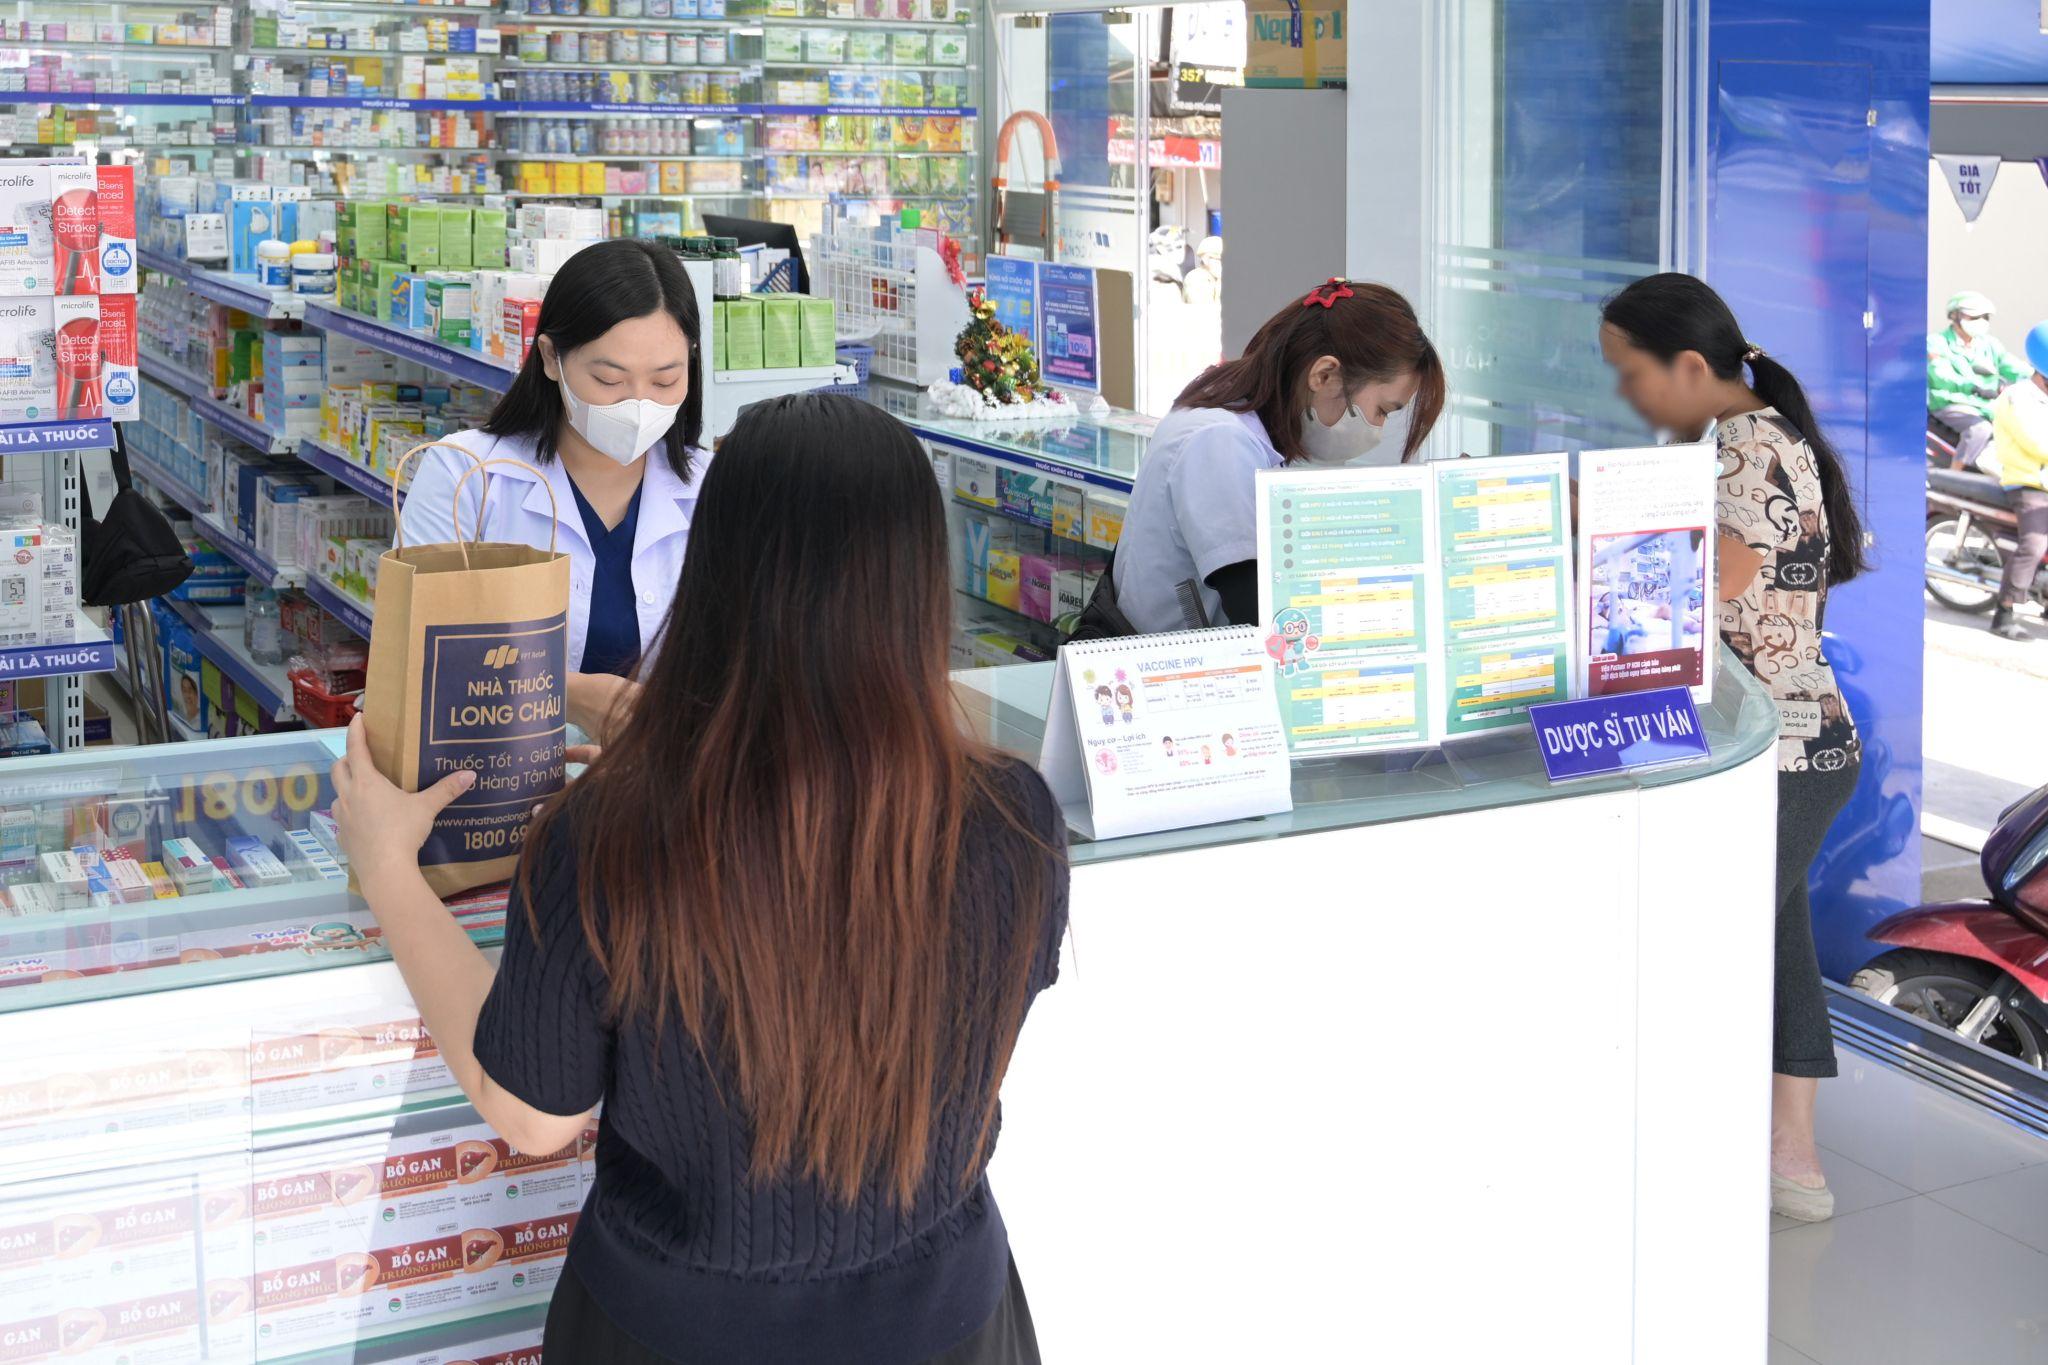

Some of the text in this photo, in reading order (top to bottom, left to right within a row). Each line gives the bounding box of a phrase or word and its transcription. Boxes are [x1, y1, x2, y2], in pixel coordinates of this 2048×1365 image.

[58, 172, 92, 180] microlife
[57, 205, 96, 216] Detect
[58, 222, 97, 233] Stroke
[61, 301, 94, 309] microlife
[60, 334, 99, 345] Detect
[61, 351, 99, 362] Stroke
[19, 388, 51, 396] Advanced
[18, 430, 40, 444] LÀ
[42, 424, 99, 443] THUỐC
[19, 653, 40, 669] LÀ
[44, 647, 100, 668] THUỐC
[1137, 656, 1204, 673] VACCINE HPV
[467, 669, 554, 697] NHÀ THUỐC
[450, 694, 561, 727] LONG CHÂU
[1544, 705, 1694, 757] DƯỢC SĨ TƯ VẤN
[1087, 738, 1106, 747] Nguy
[434, 753, 485, 772] Thuốc
[488, 751, 512, 769] Tốt
[530, 747, 551, 764] Giá
[479, 776, 520, 792] Hàng
[523, 769, 547, 788] Tận
[463, 829, 506, 851] 1800
[376, 1024, 397, 1045] BỔ
[269, 1044, 305, 1061] GAN
[385, 1155, 442, 1178] BỔ GAN
[425, 1167, 456, 1182] PHÚC
[257, 1179, 316, 1201] BỔ GAN
[140, 1208, 176, 1225] GAN
[1, 1232, 37, 1250] GAN
[515, 1222, 569, 1245] BỔ GAN
[391, 1245, 448, 1268] BỔ GAN
[379, 1256, 462, 1282] TRƯỜNG PHÚC
[262, 1270, 321, 1293] BỔ GAN
[145, 1301, 182, 1320] GAN
[3, 1327, 41, 1346] GAN
